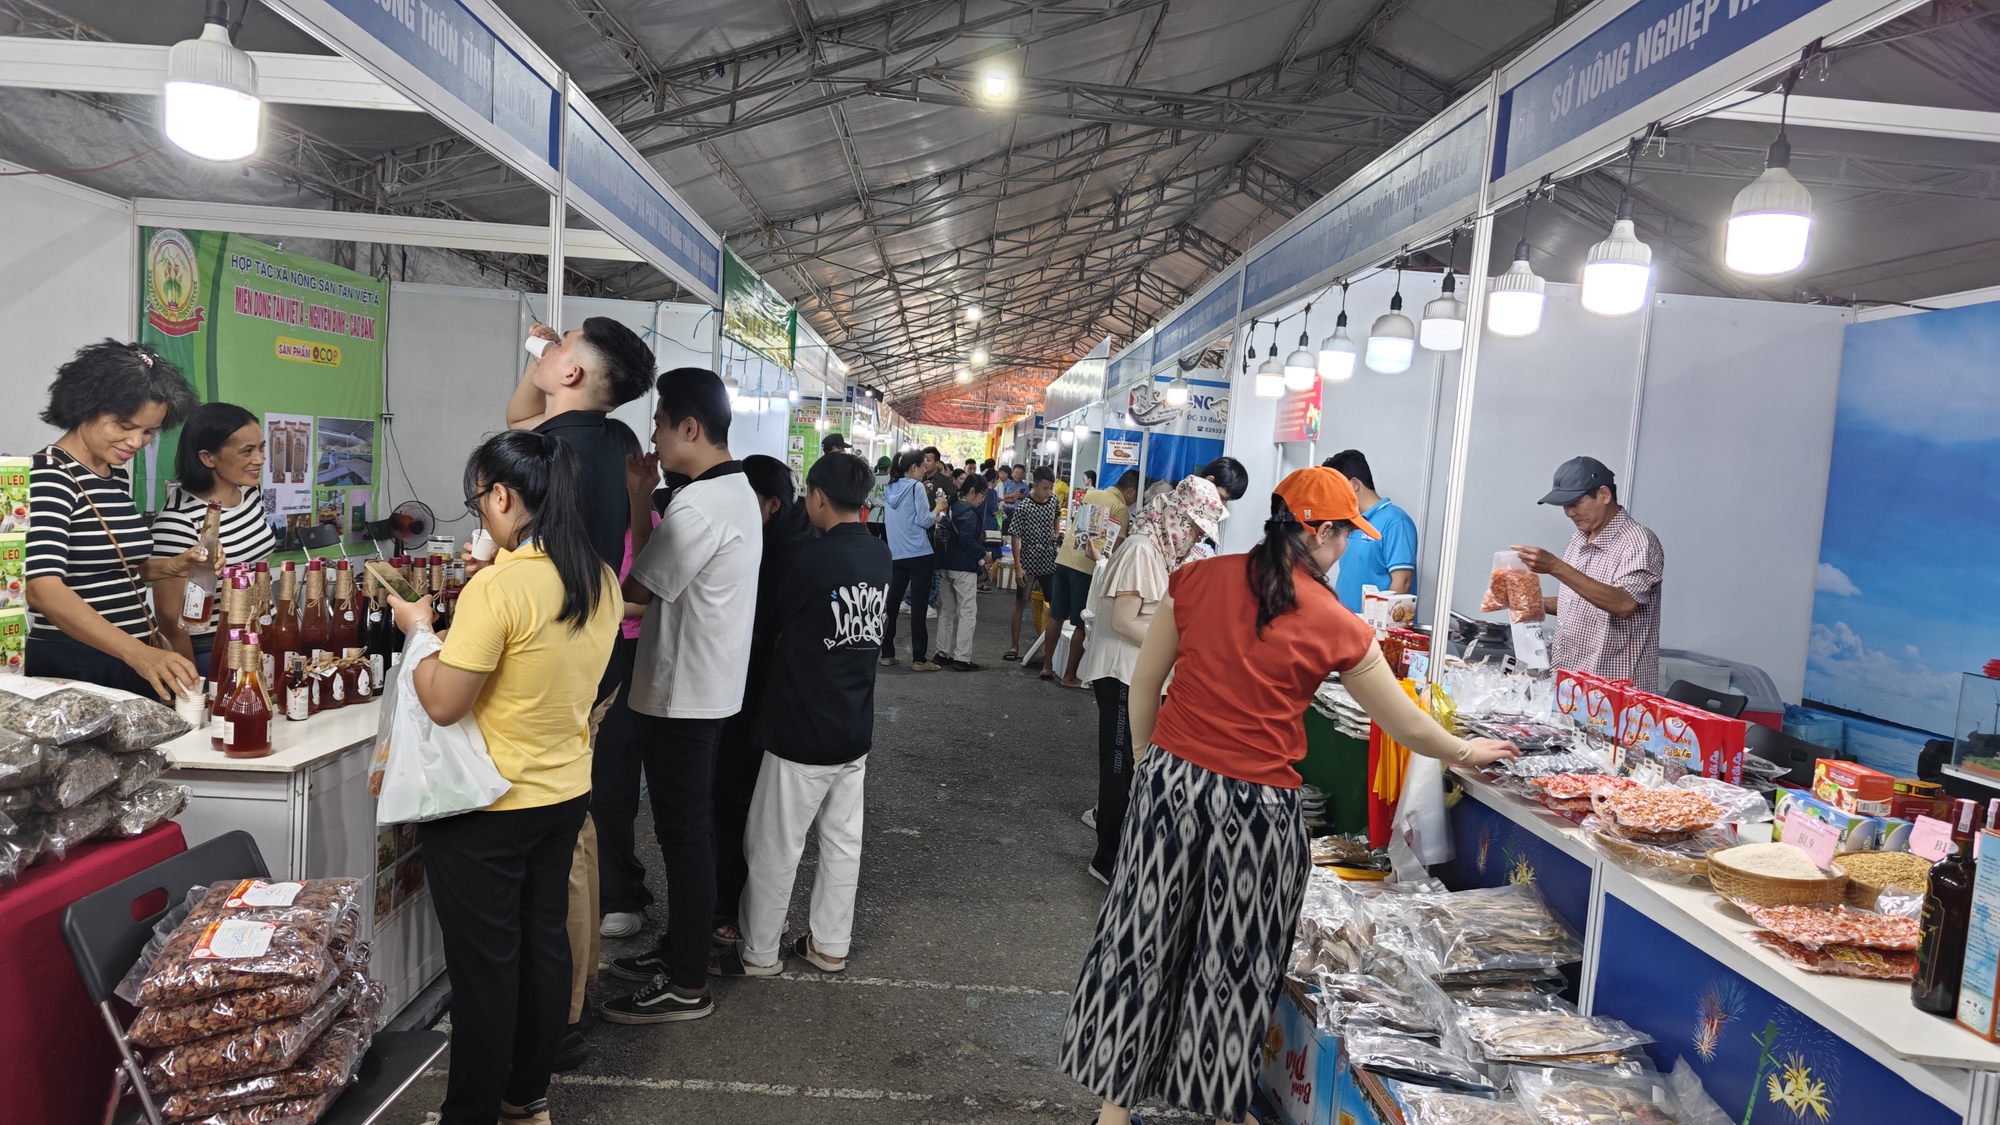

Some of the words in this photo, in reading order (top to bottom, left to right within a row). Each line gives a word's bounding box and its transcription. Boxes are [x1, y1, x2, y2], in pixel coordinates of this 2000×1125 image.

[419, 1, 458, 66] THÔN
[462, 32, 492, 93] TỈNH
[1550, 65, 1575, 122] SỞ
[1576, 42, 1631, 108] NÔNG
[1634, 0, 1720, 75] NGHIỆP
[231, 253, 252, 274] HỢP
[255, 258, 273, 277] TÁC
[276, 265, 289, 283] XÃ
[290, 269, 317, 290] NÔNG
[319, 275, 336, 294] SẢN
[338, 282, 353, 300] TÂN
[354, 287, 373, 306] VIỆT
[253, 290, 271, 320] DONG
[278, 342, 292, 357] SẢN
[293, 343, 311, 359] PHẨM
[7, 474, 25, 486] LEO
[2, 549, 20, 561] LEO
[3, 623, 20, 636] LEO
[1797, 832, 1814, 849] BL9
